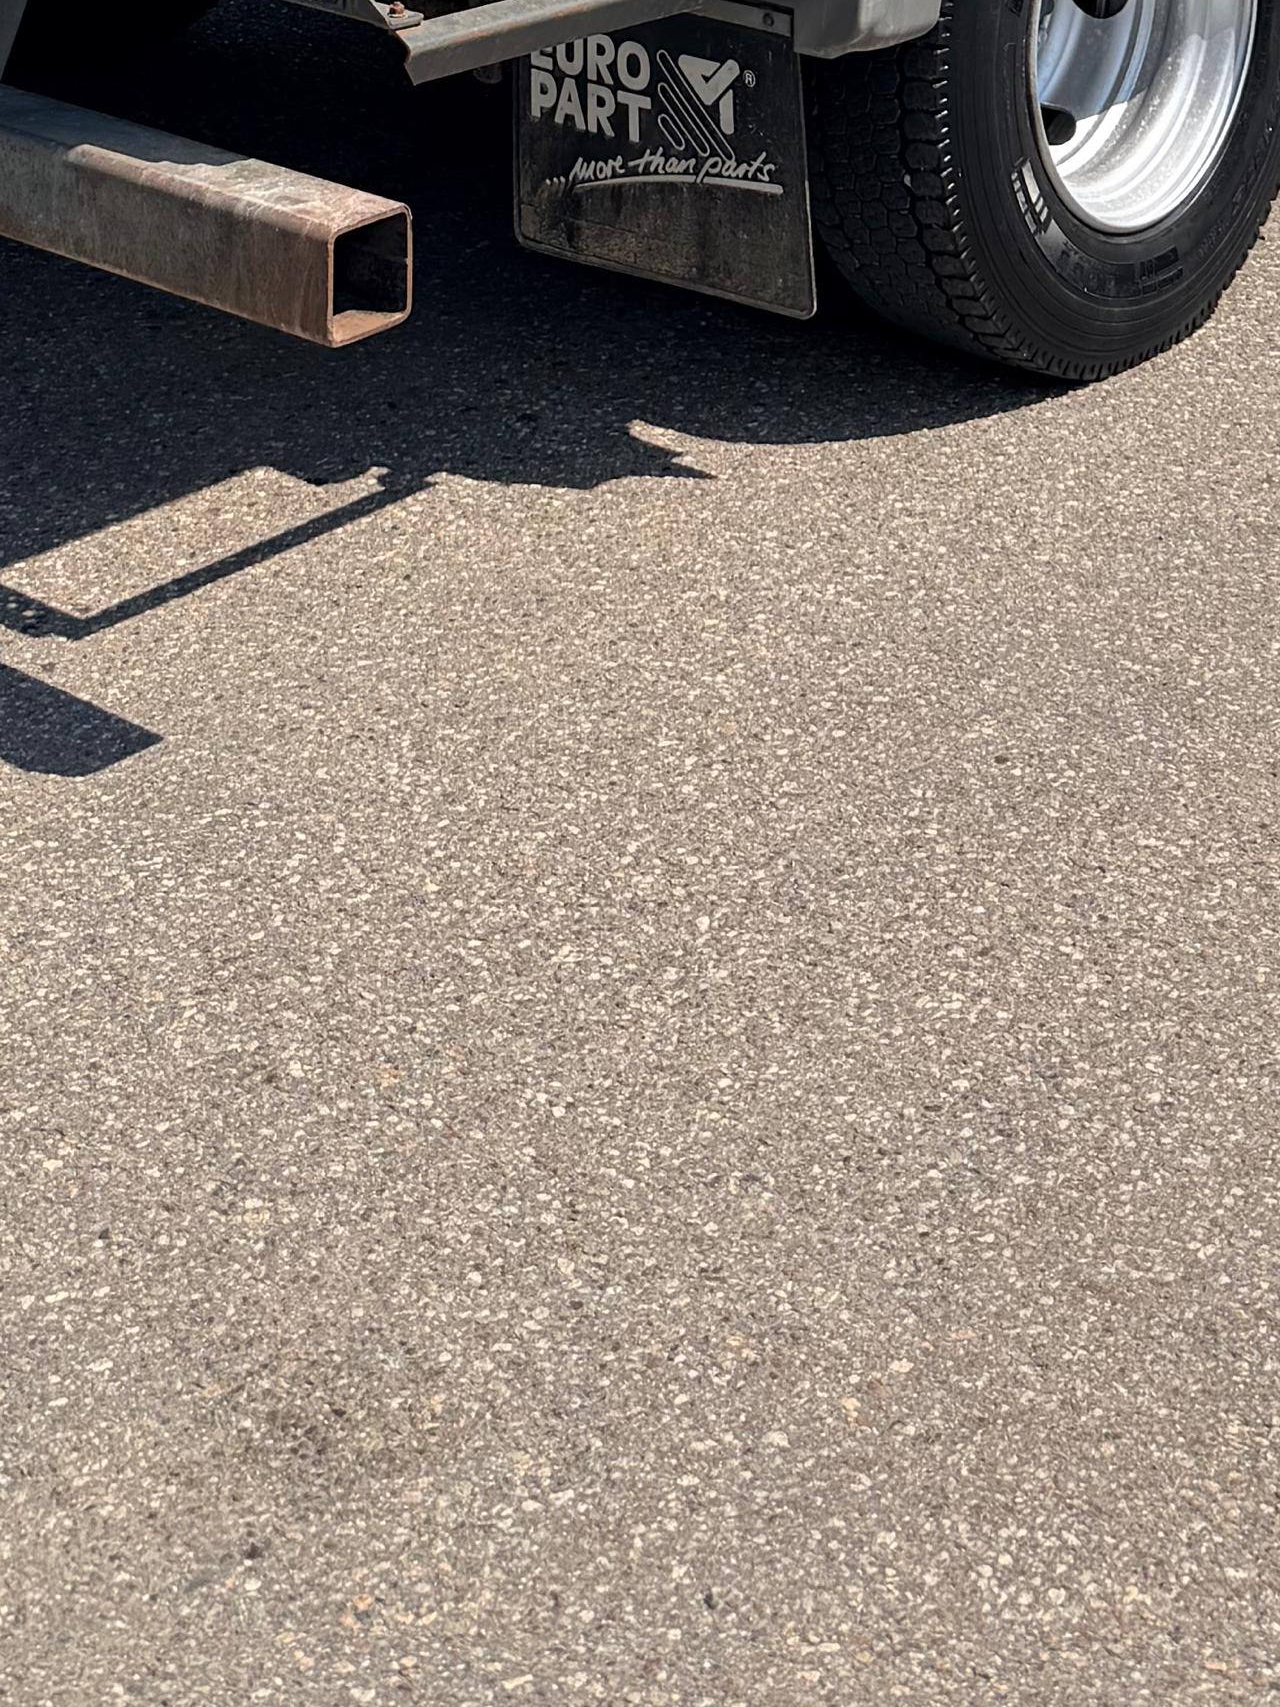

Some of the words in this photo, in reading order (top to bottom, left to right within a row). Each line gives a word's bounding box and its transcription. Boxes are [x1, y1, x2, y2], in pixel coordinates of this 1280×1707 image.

[530, 67, 652, 144] PART
[628, 146, 696, 175] than
[695, 151, 775, 185] parts
